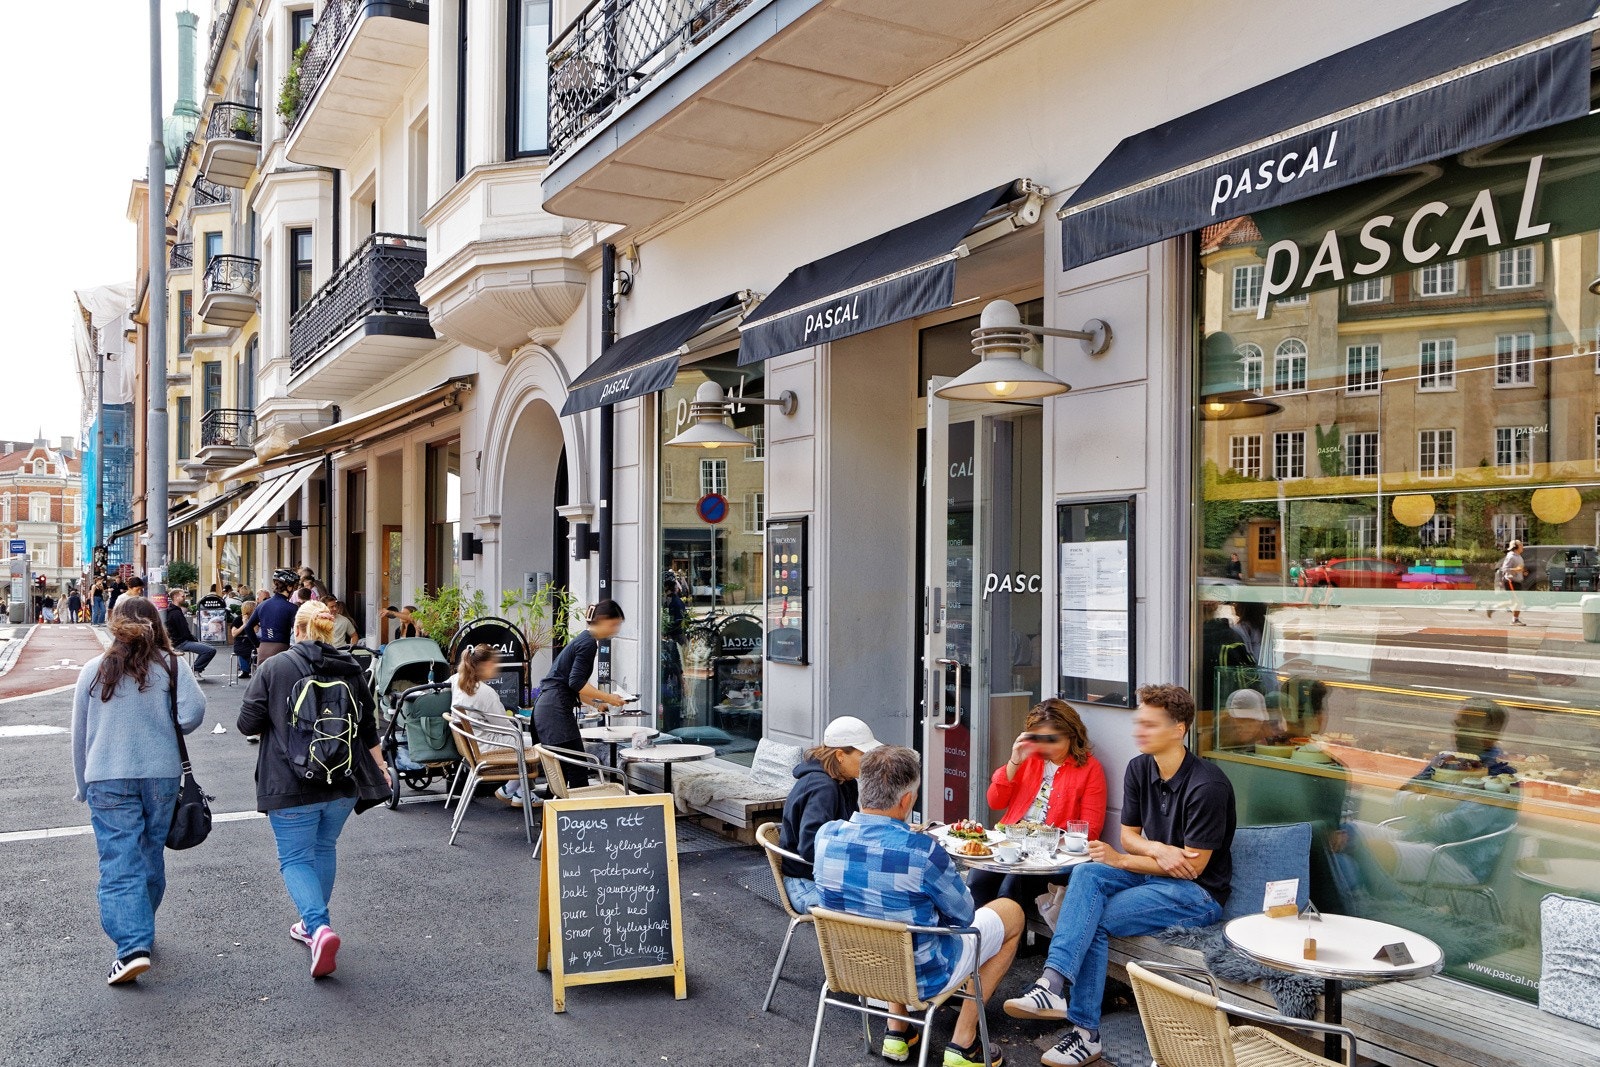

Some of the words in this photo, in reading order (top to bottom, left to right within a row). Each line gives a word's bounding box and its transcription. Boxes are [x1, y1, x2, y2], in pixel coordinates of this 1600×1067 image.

[558, 816, 608, 840] Dagens
[616, 812, 645, 827] rett
[560, 841, 595, 856] Stekt
[563, 865, 581, 879] med
[562, 885, 588, 899] bakt
[561, 909, 588, 928] purre
[595, 904, 621, 926] laget
[627, 902, 648, 916] med
[565, 927, 595, 941] smør
[603, 927, 612, 943] og
[616, 918, 670, 942] kyllingkraft
[583, 947, 603, 967] også
[609, 943, 635, 958] Take
[638, 942, 669, 962] Away
[1467, 961, 1541, 989] www.pascal.no
